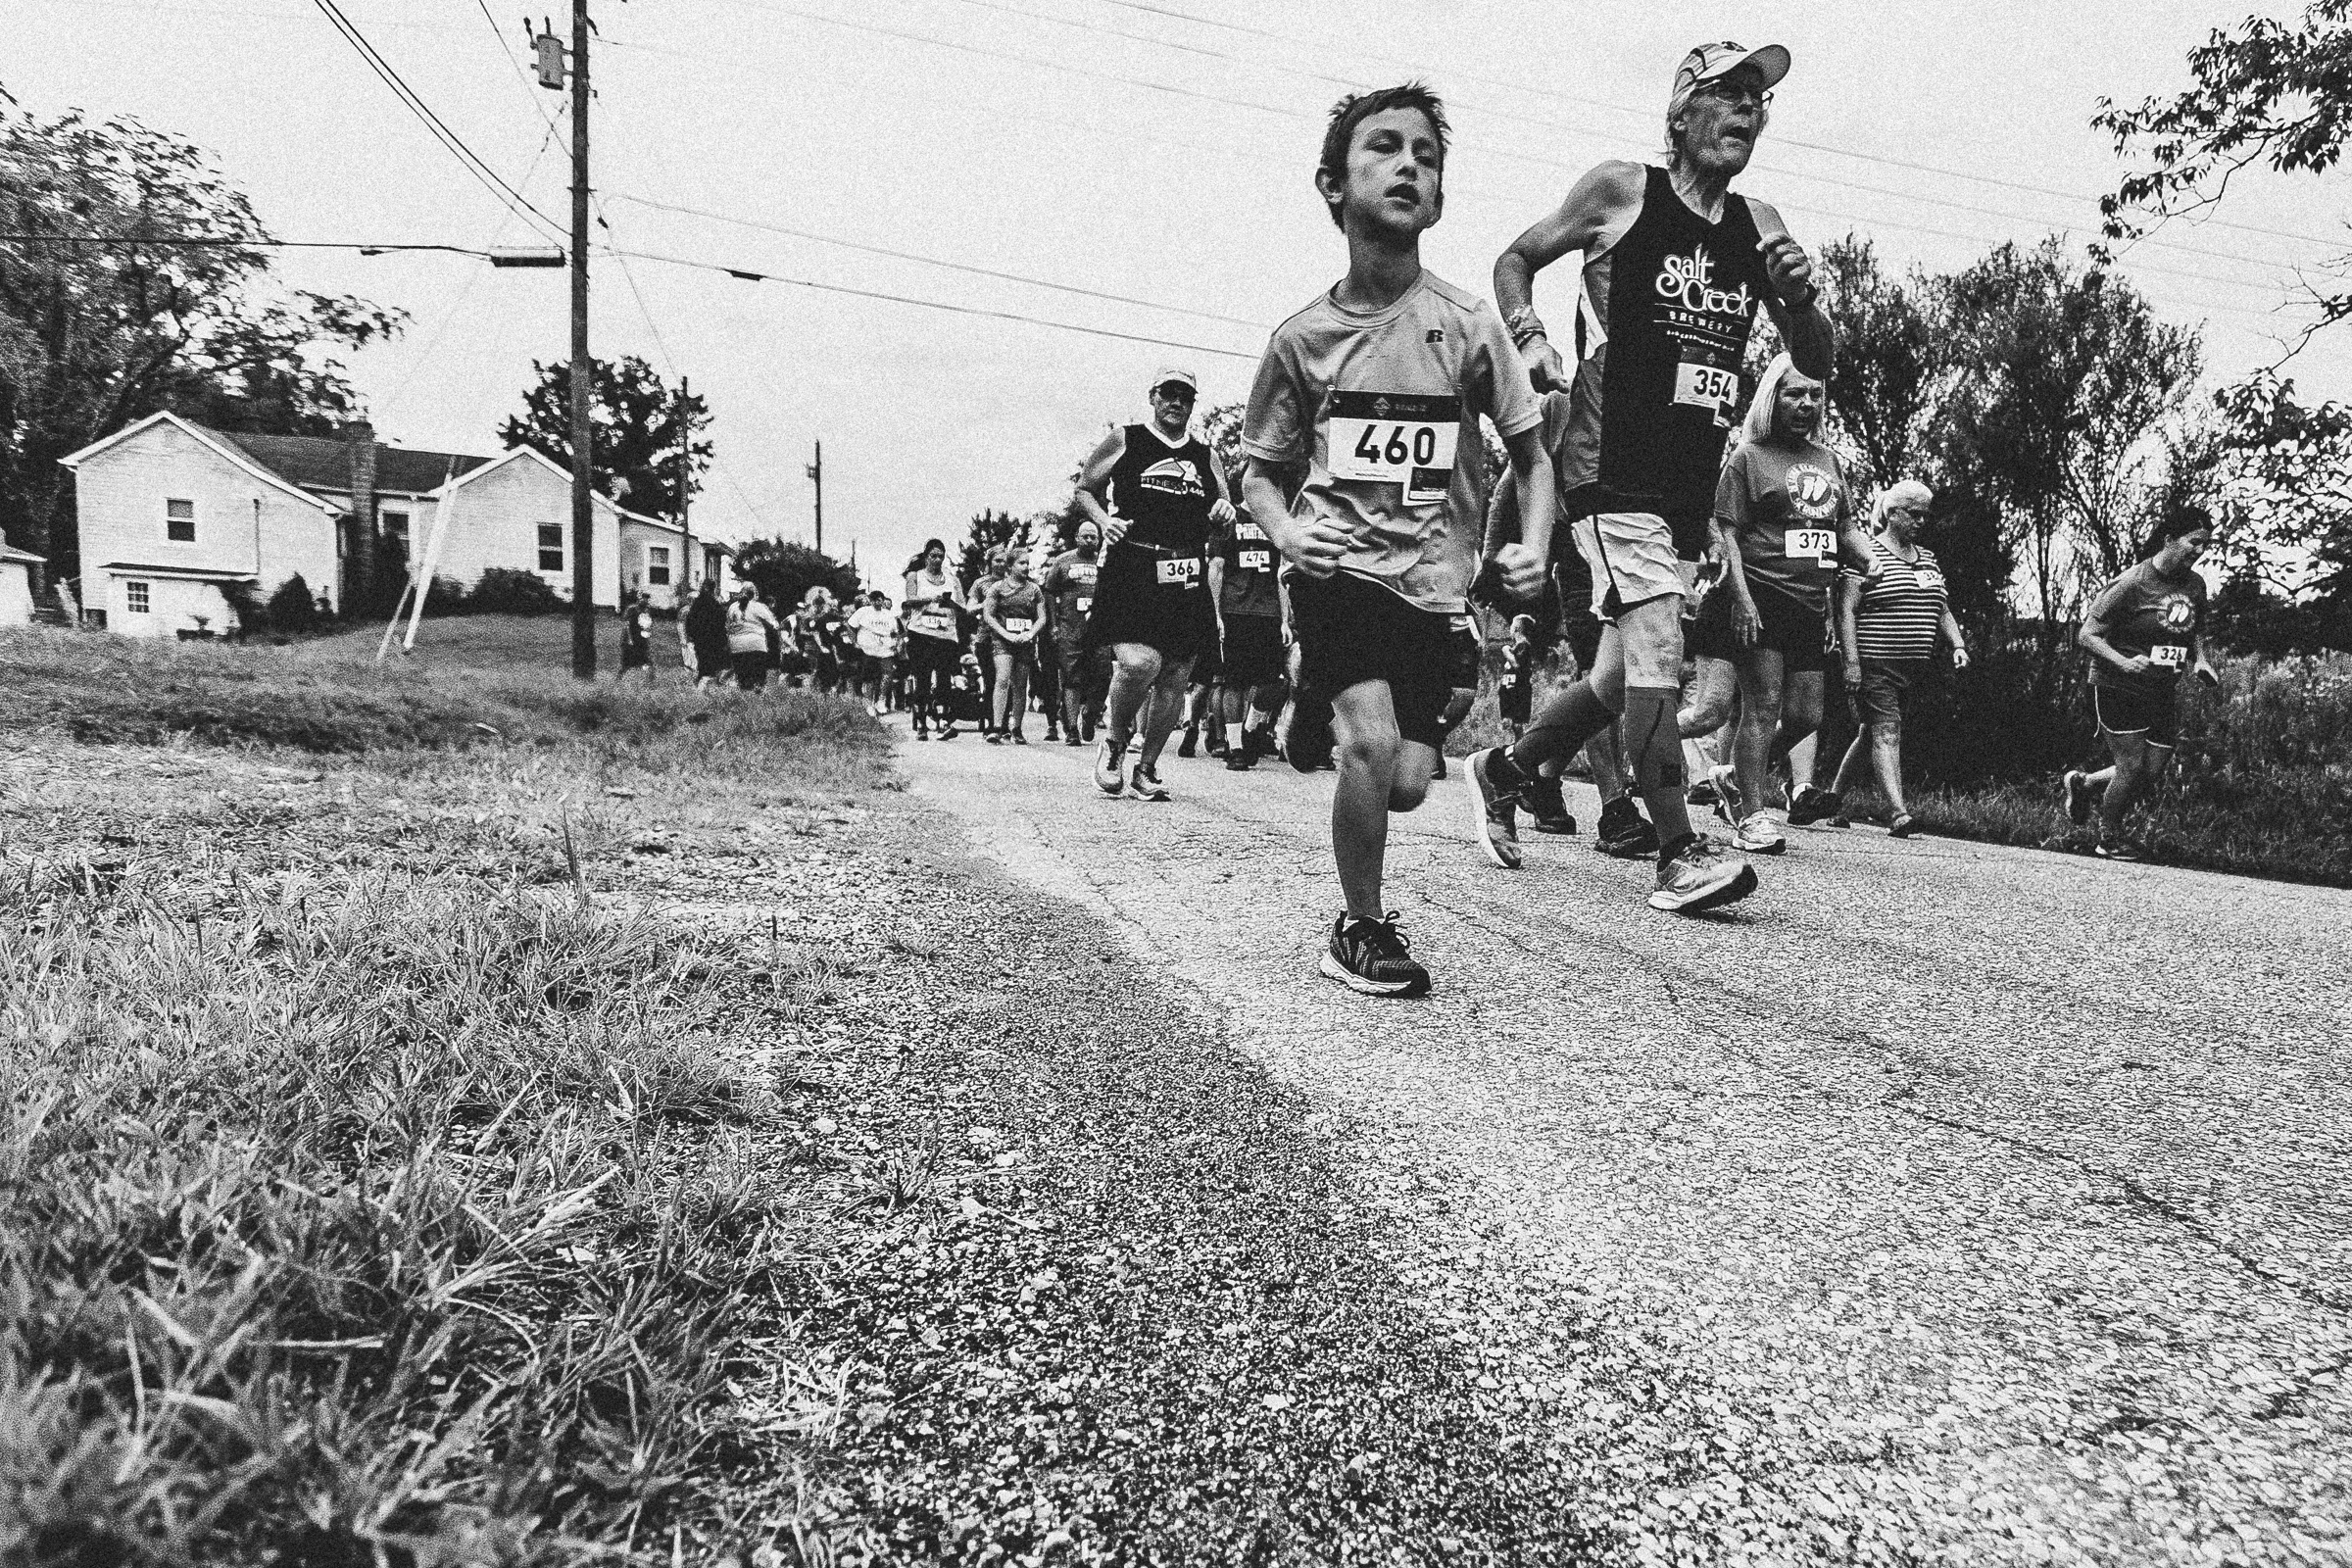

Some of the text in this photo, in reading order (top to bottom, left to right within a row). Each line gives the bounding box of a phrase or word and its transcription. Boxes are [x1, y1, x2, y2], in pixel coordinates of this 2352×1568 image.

[1655, 243, 1715, 297] Salt
[1682, 278, 1752, 317] Creek
[1669, 311, 1733, 333] BREWERY
[1693, 369, 1732, 402] 354
[1354, 423, 1436, 466] 460
[1799, 532, 1830, 550] 373
[1166, 561, 1194, 576] 366
[1246, 553, 1265, 562] 474
